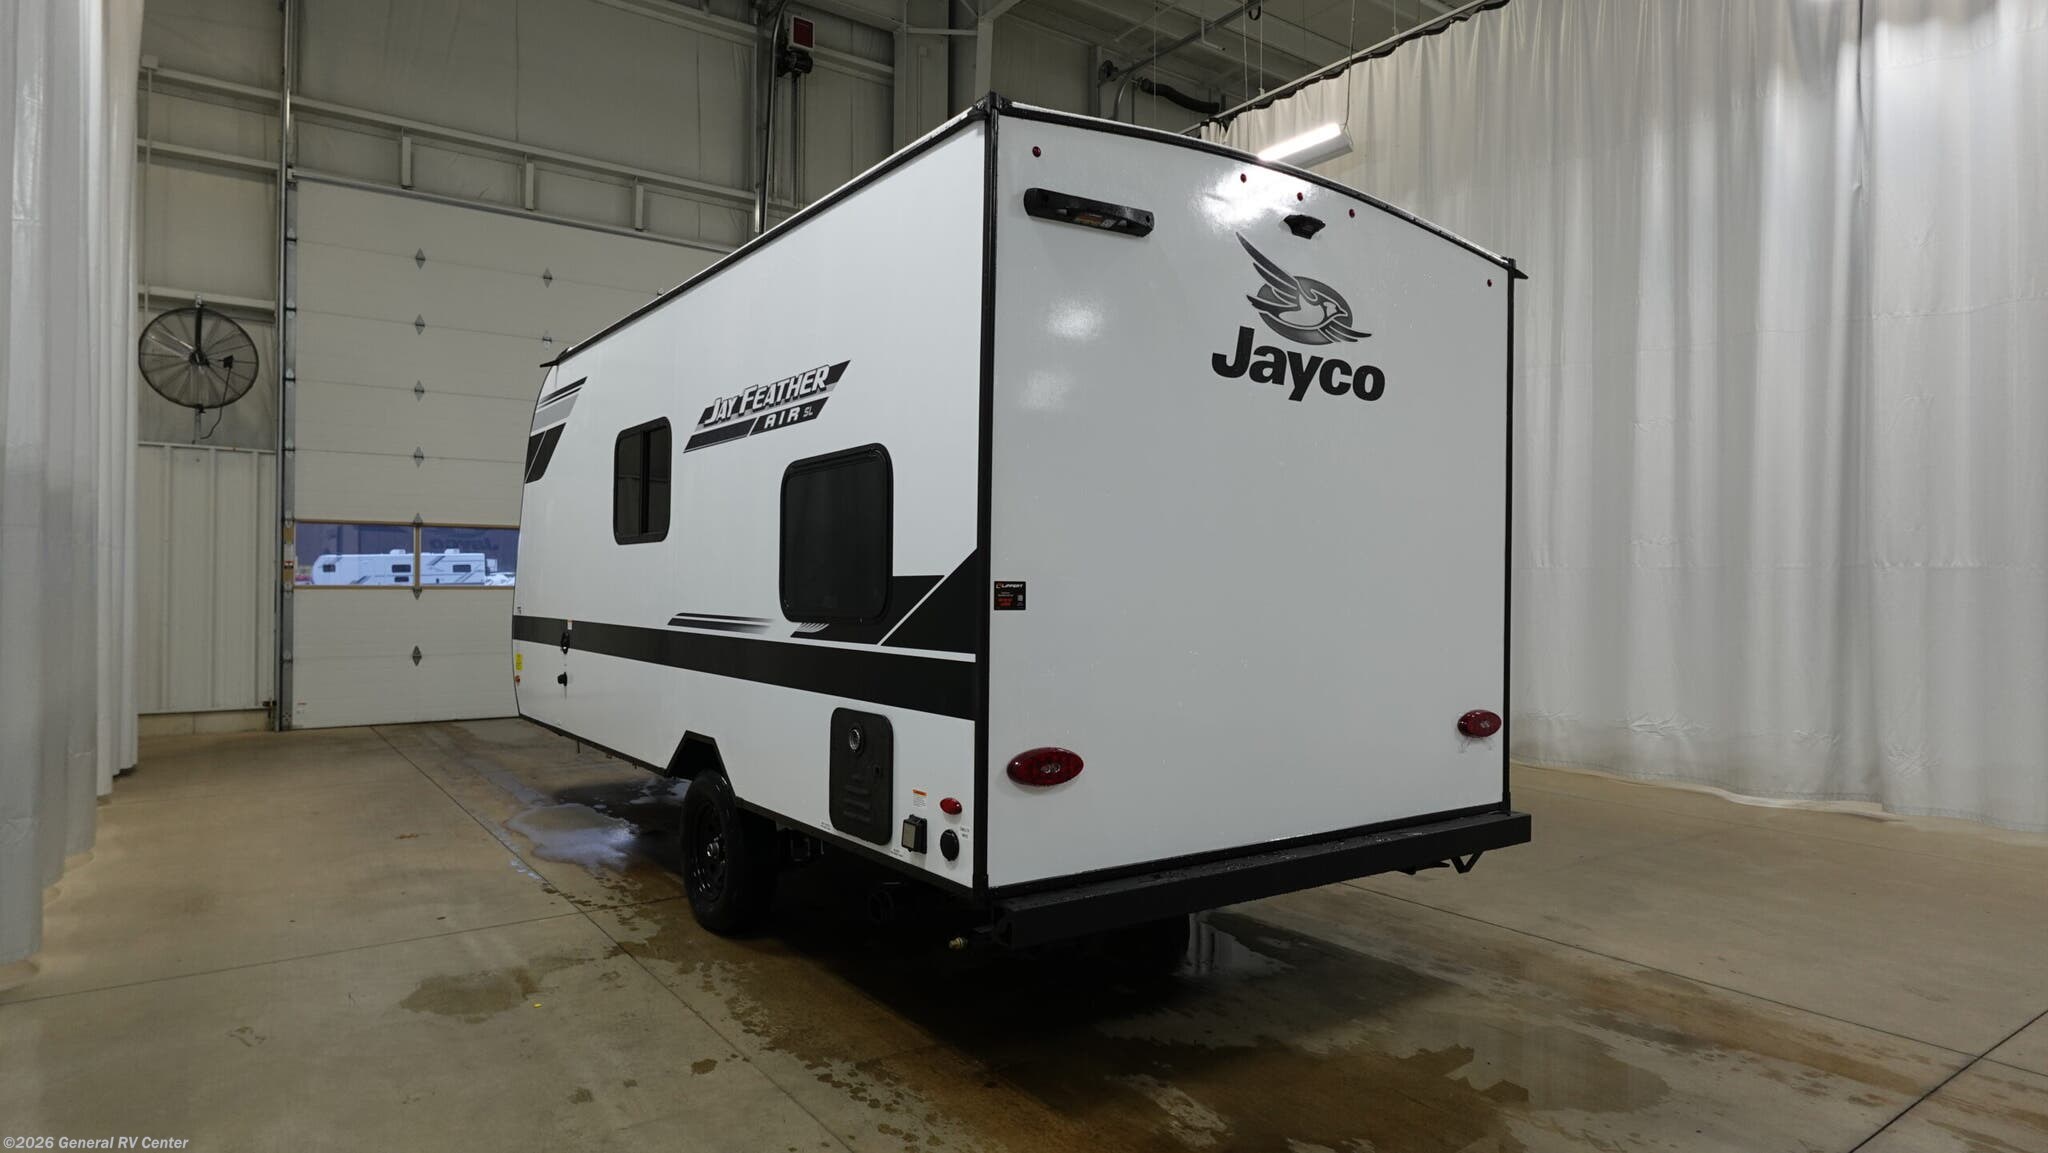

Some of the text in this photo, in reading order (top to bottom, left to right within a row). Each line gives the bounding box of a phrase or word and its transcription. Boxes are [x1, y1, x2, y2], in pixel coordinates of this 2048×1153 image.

[1211, 325, 1386, 402] Jayco
[704, 364, 830, 426] JAY FEATHER
[763, 406, 814, 430] AIR SL
